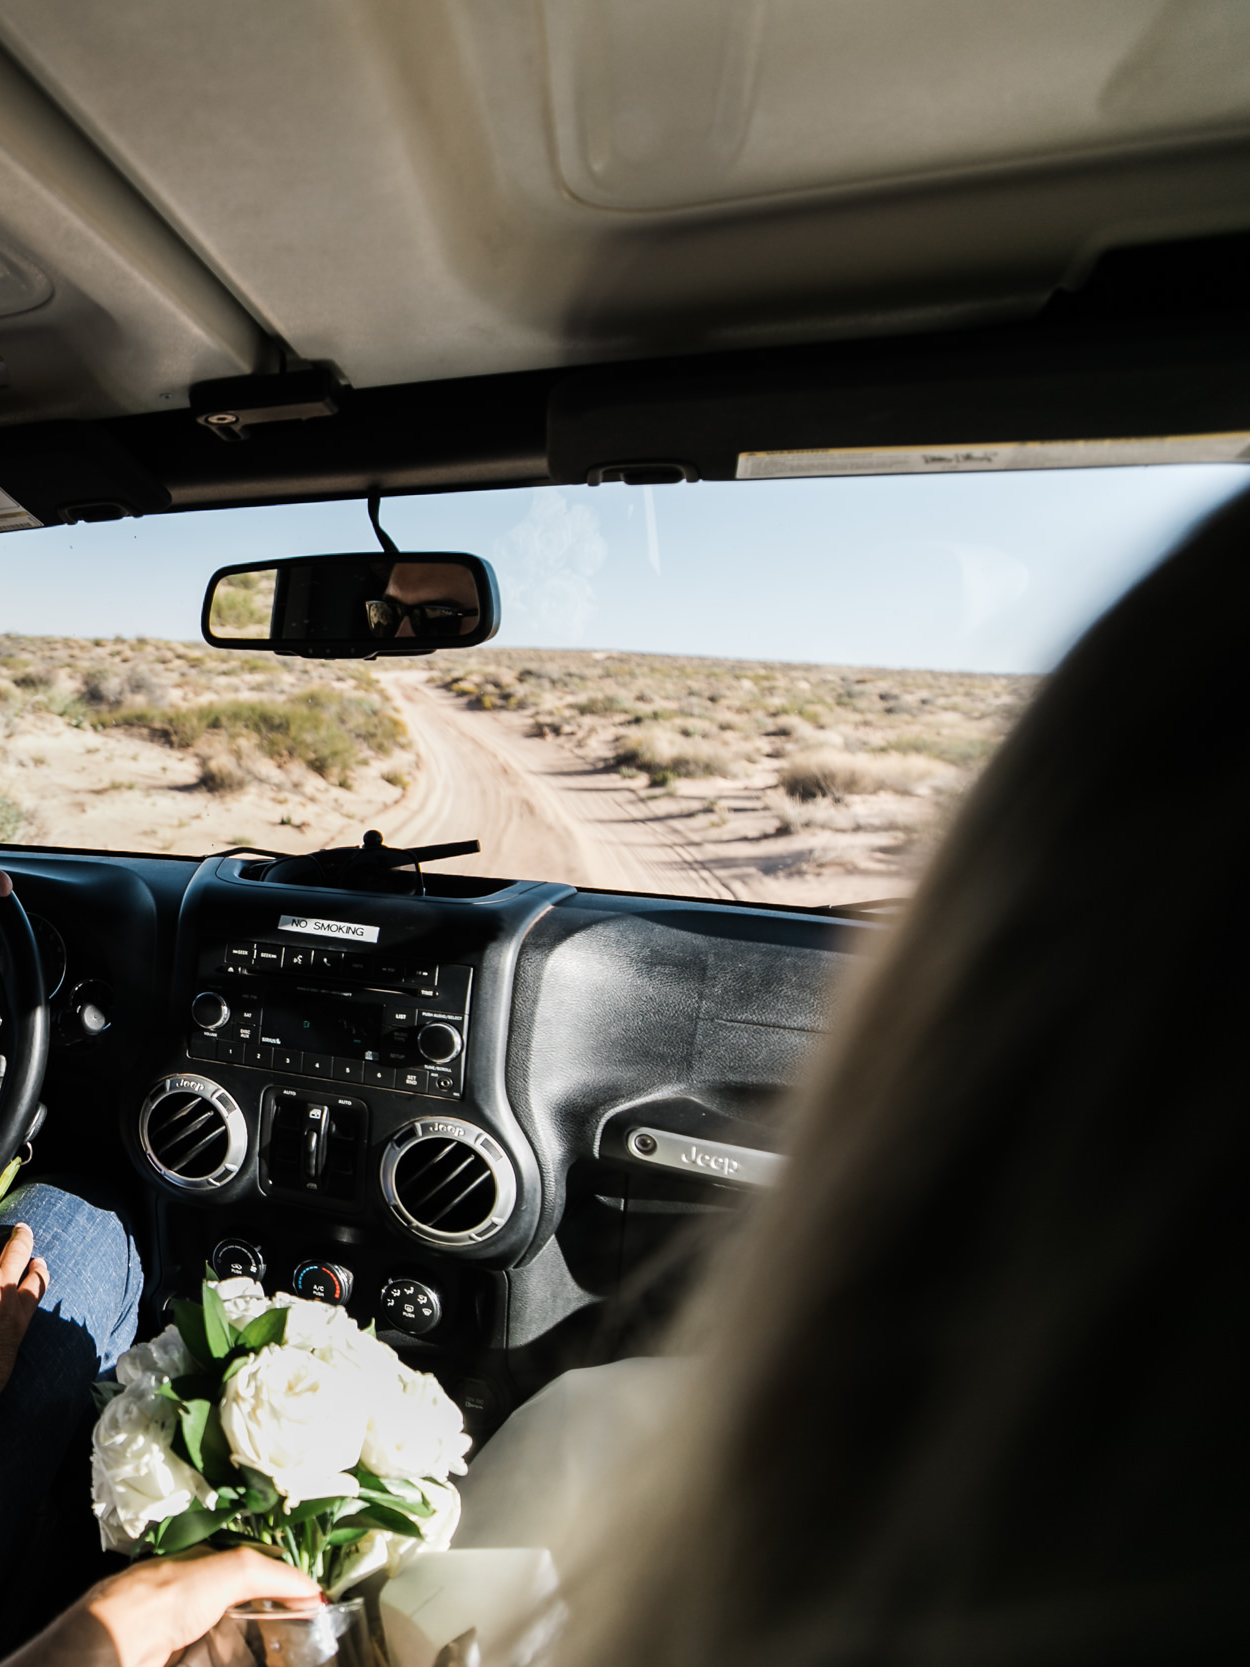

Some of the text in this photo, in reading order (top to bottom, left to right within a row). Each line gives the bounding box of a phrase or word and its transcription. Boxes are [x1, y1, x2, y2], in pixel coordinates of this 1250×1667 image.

[291, 919, 365, 936] NO SMOKING
[175, 1078, 205, 1092] Jeep
[429, 1122, 465, 1137] Jeep
[680, 1145, 739, 1175] Jeep
[312, 1284, 325, 1292] A/C
[402, 1311, 415, 1319] PUSH
